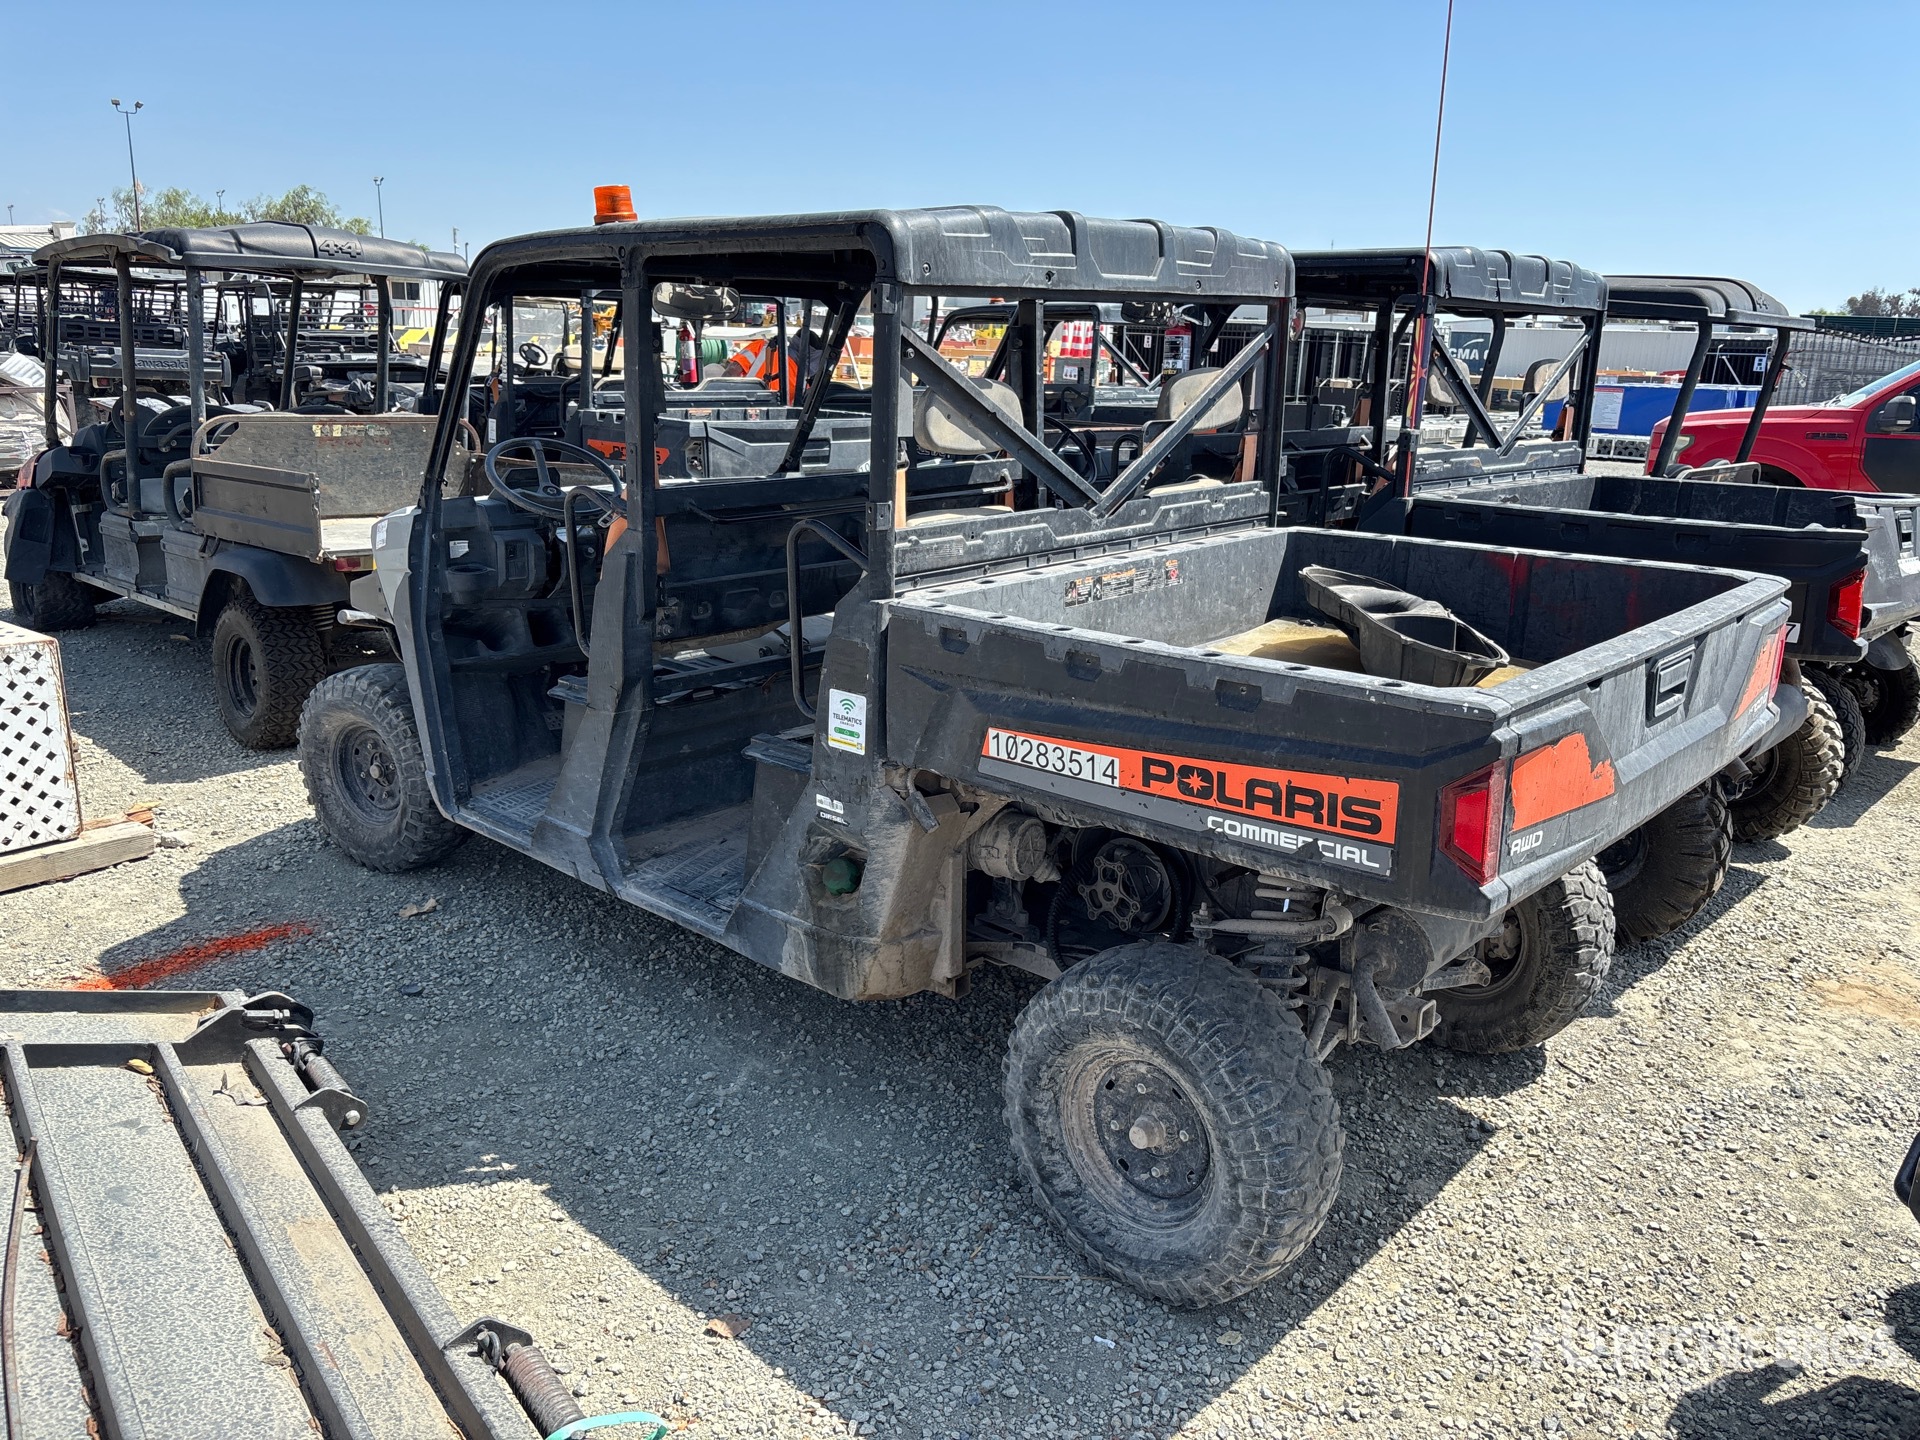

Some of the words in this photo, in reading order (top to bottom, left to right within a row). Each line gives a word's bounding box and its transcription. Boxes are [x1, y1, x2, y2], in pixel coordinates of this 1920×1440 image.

[1448, 348, 1479, 360] CMA
[133, 358, 189, 370] awasaki
[832, 712, 862, 726] TELEMATICS
[991, 732, 1118, 786] 10283514
[1141, 756, 1382, 835] POLARIS
[820, 811, 849, 826] DIESEL
[1510, 830, 1543, 856] AWD
